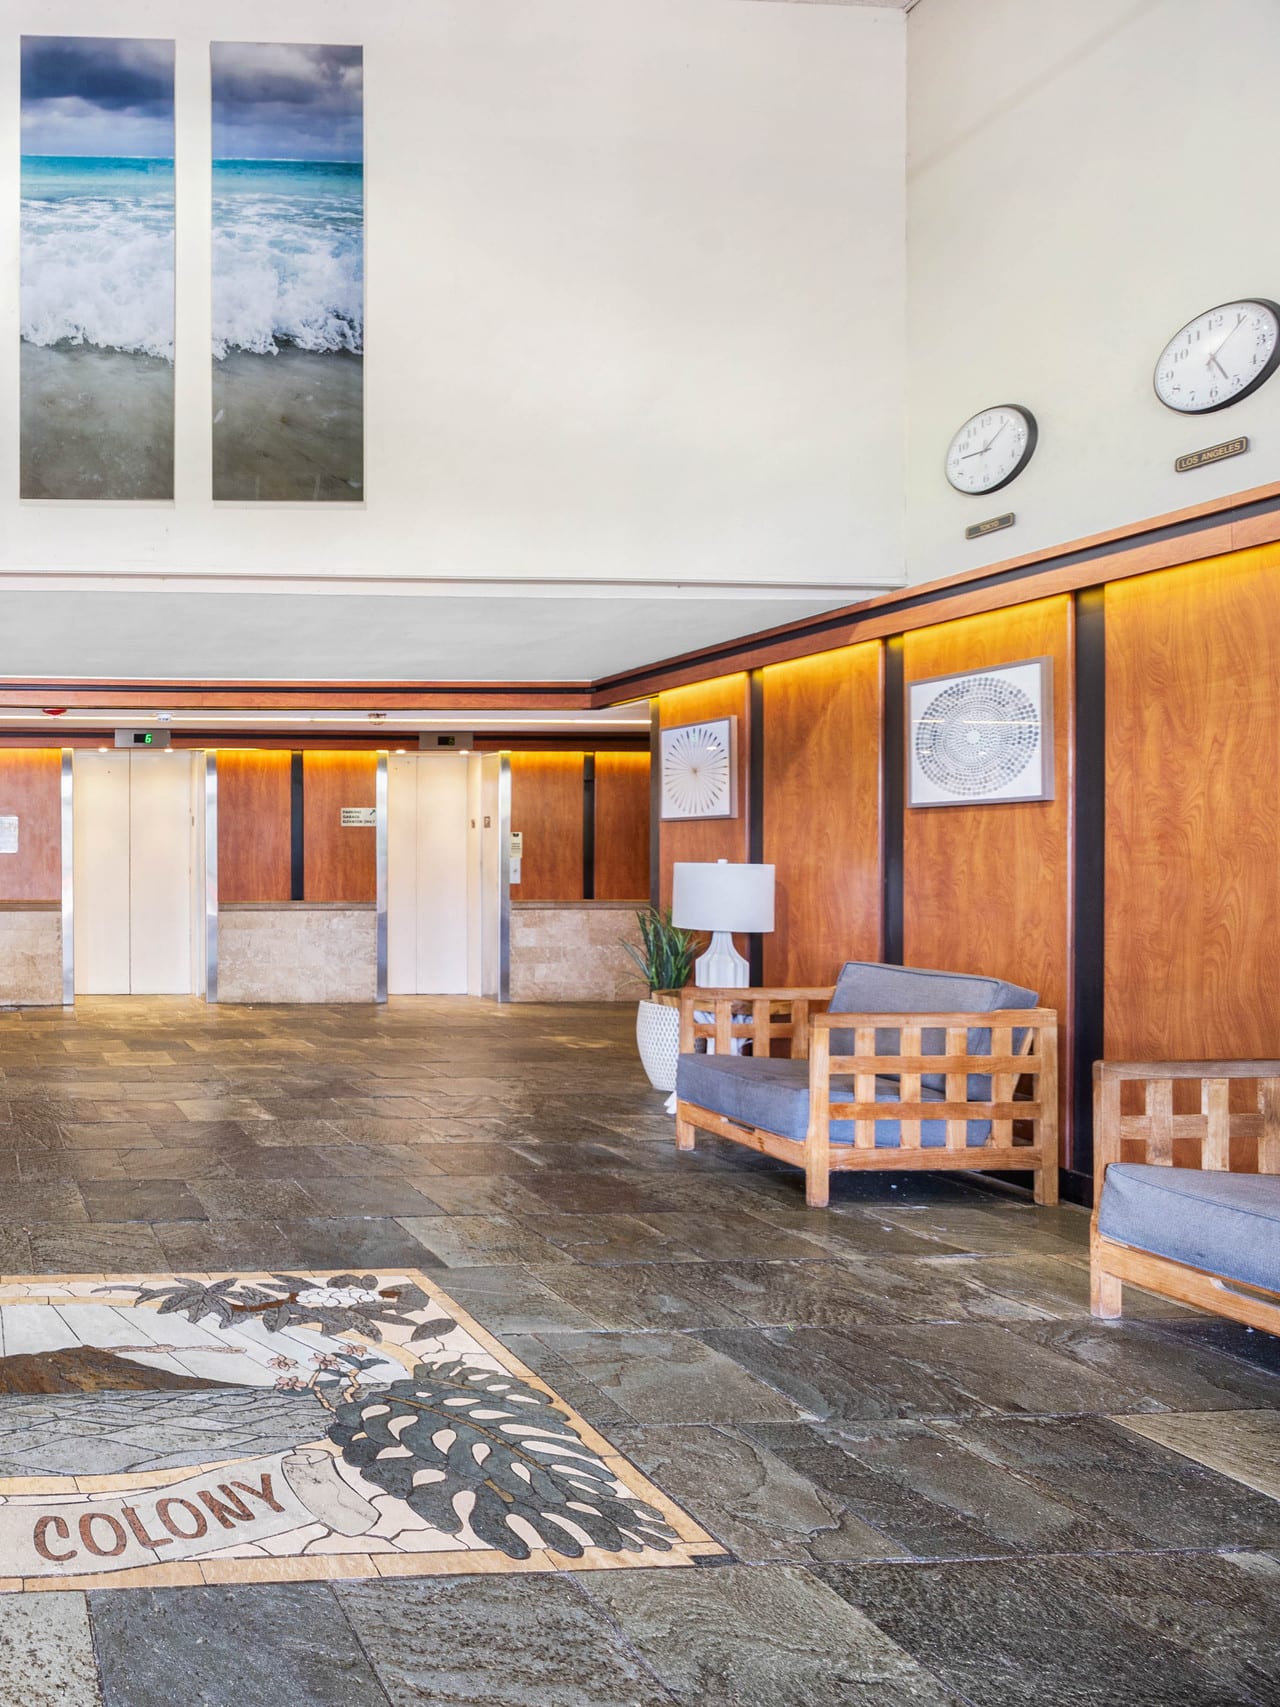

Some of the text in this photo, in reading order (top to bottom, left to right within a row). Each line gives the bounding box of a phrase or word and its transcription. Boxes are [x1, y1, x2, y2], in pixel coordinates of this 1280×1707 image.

[1207, 315, 1223, 331] 12
[1186, 330, 1200, 345] 11
[1174, 348, 1189, 364] 10
[1166, 370, 1174, 383] 9
[1182, 442, 1241, 467] LOS ANGELES
[145, 733, 152, 744] 6
[32, 1473, 286, 1562] COLONY
